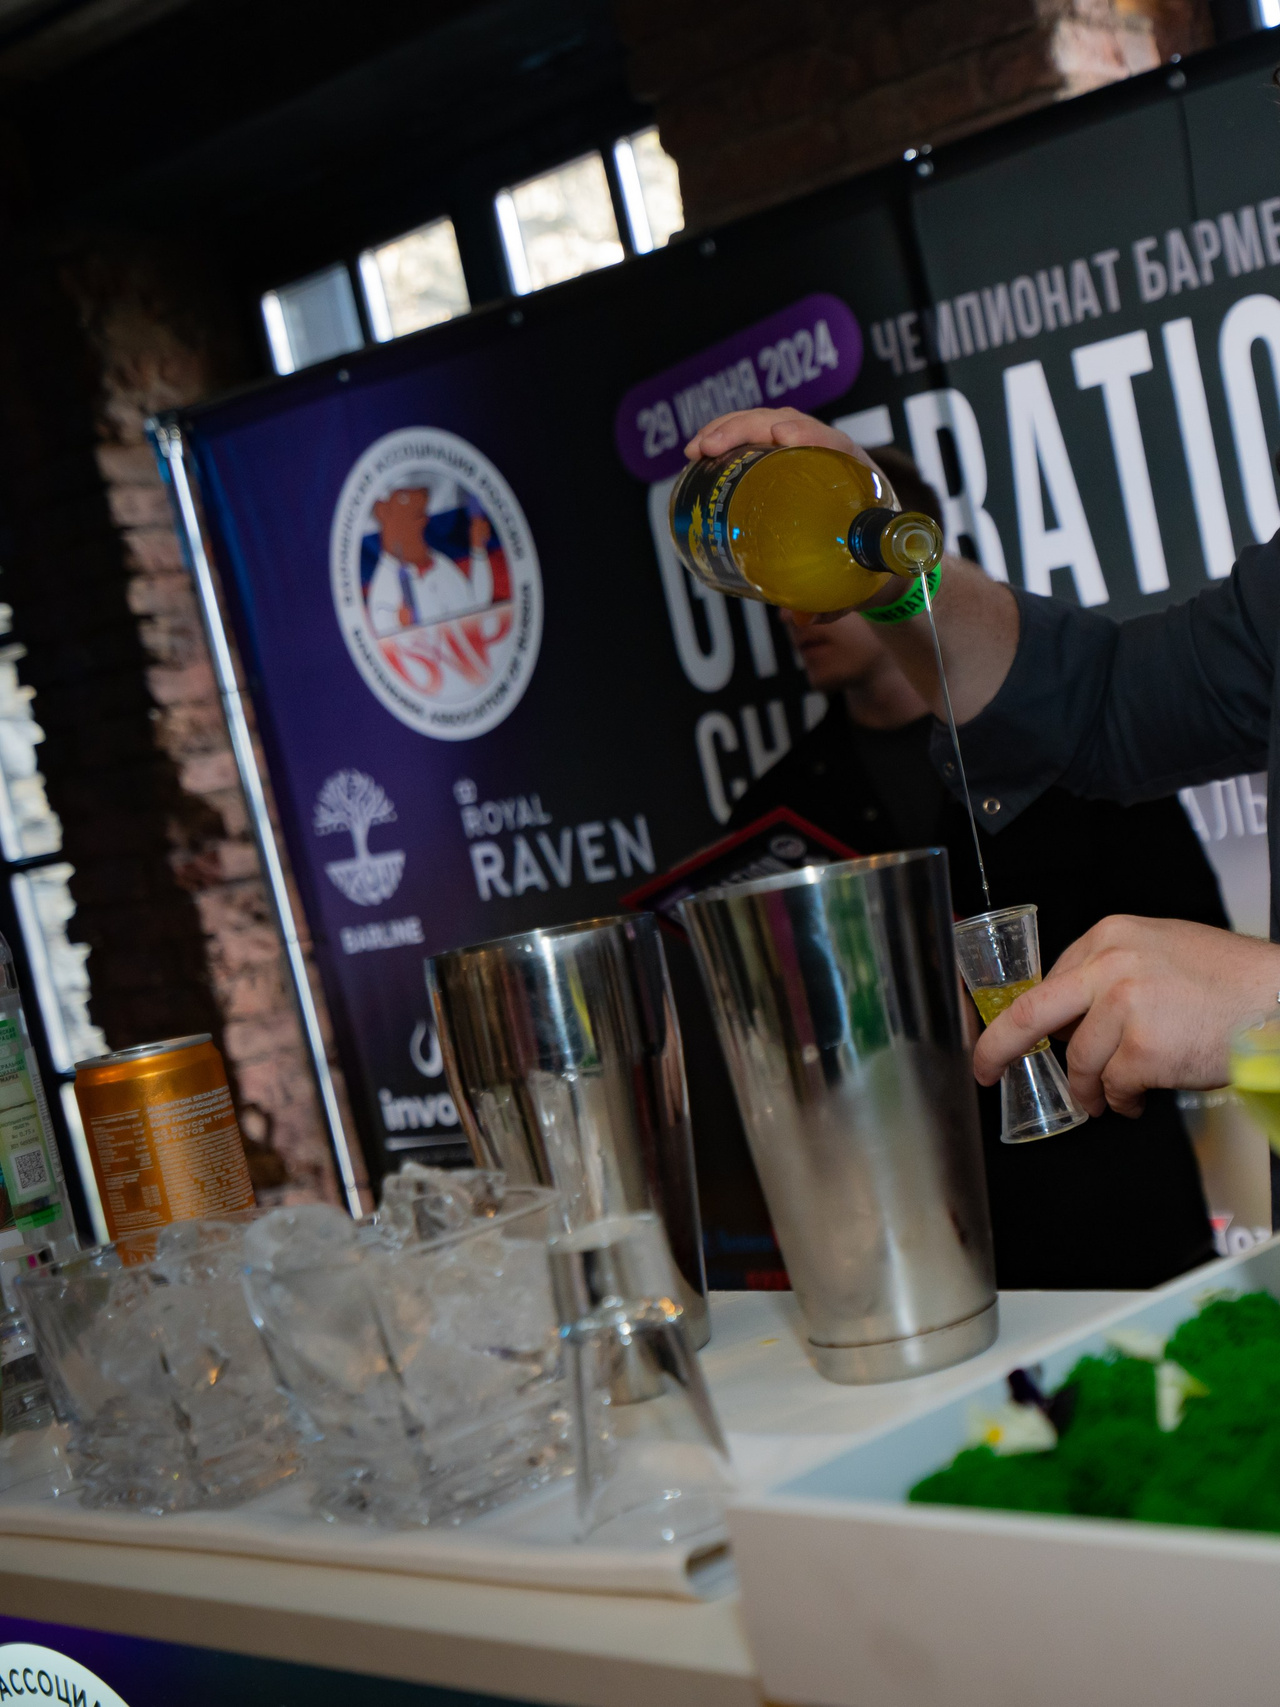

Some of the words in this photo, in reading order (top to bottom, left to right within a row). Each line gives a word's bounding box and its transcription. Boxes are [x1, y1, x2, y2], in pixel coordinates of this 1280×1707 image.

[870, 249, 1122, 377] ЧЕМПИОНАТ
[636, 401, 679, 459] 29
[757, 319, 839, 399] 2024
[461, 793, 553, 839] ROYAL
[469, 812, 657, 901] RAVEN
[0, 1667, 102, 1707] АССОЦИ
